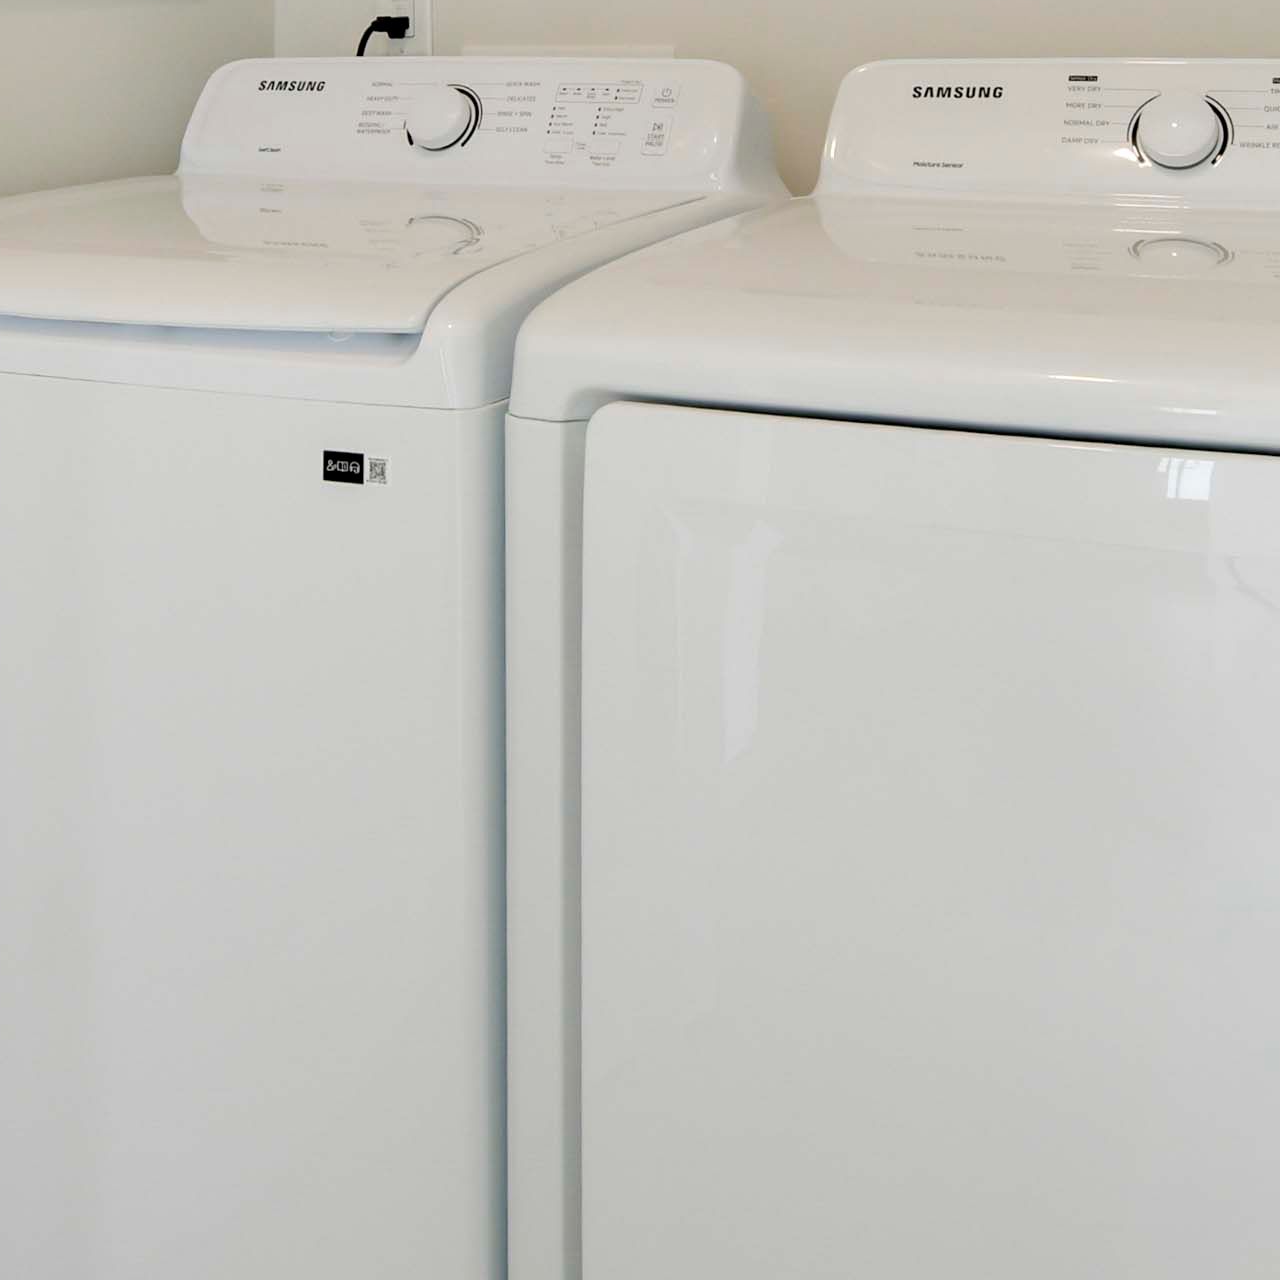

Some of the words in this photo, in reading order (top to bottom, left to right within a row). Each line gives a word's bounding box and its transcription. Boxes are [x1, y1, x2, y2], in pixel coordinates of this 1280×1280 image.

[258, 80, 326, 92] SAMSUNG
[912, 86, 1004, 99] SAMSUNG
[1063, 119, 1094, 127] NORMAL
